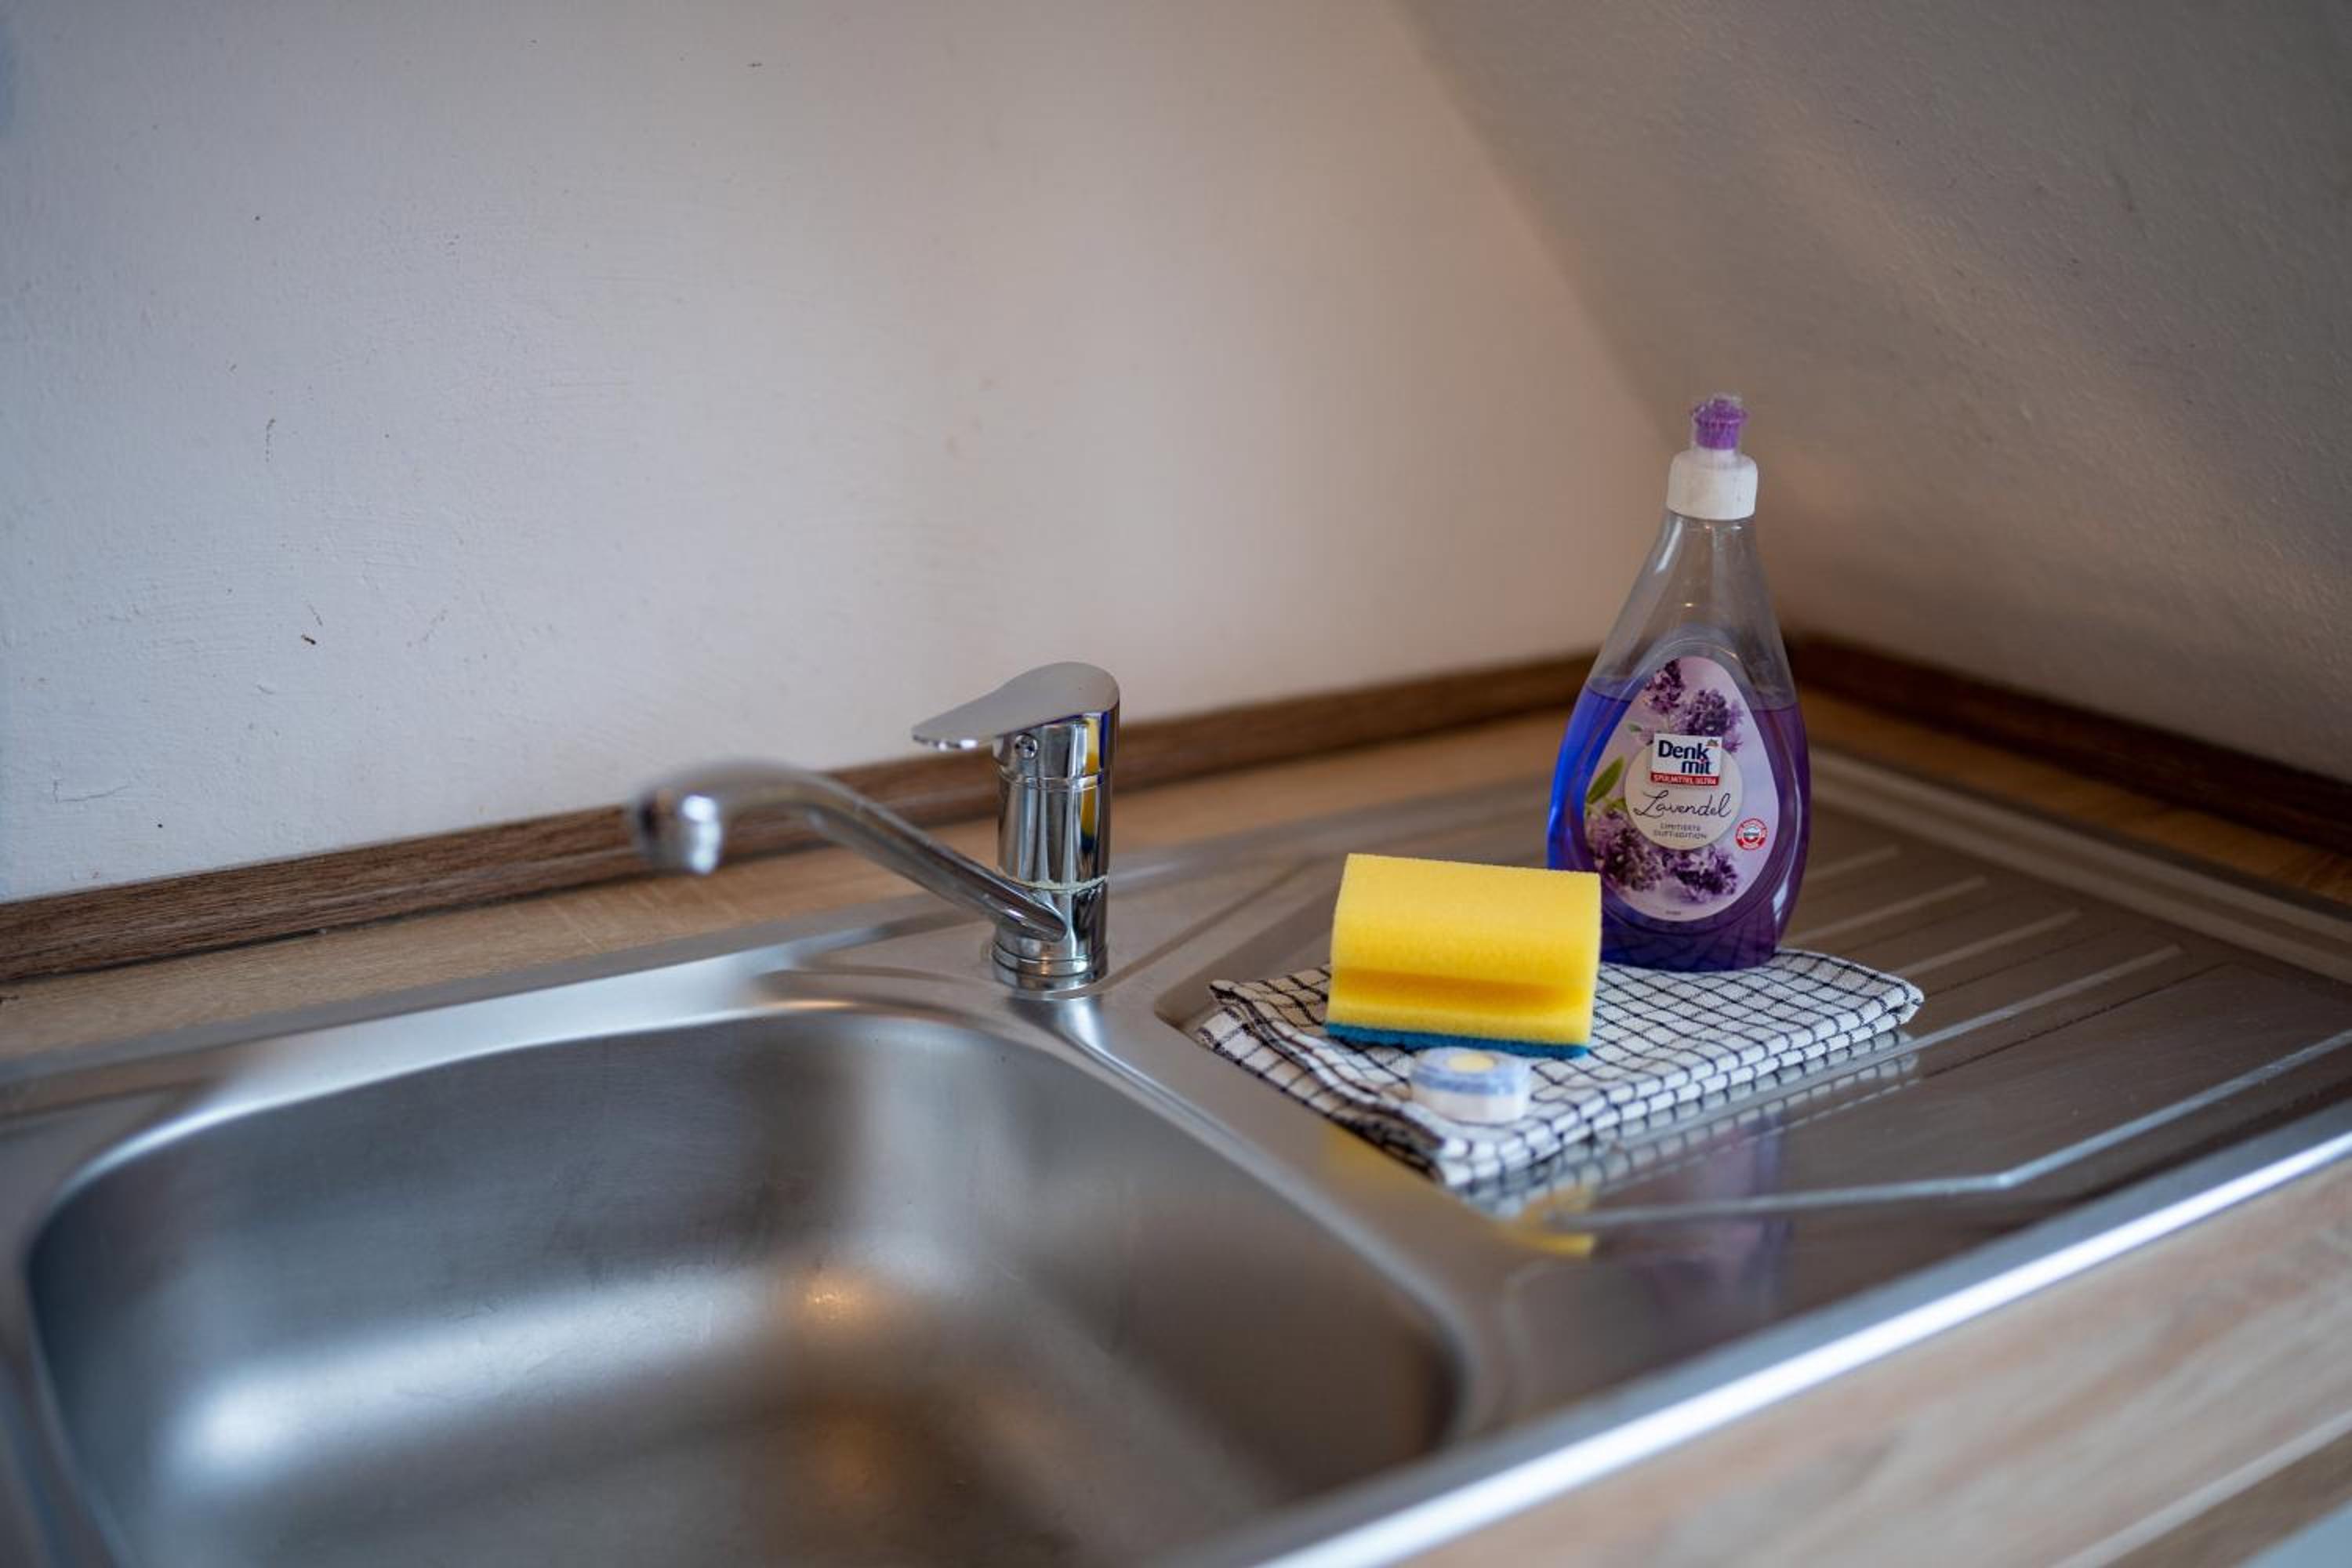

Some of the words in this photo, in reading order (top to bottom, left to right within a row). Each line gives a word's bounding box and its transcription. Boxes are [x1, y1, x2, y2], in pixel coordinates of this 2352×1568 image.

[1658, 739, 1708, 759] Denk
[1682, 758, 1711, 775] mit
[1633, 789, 1732, 818] Lavendel
